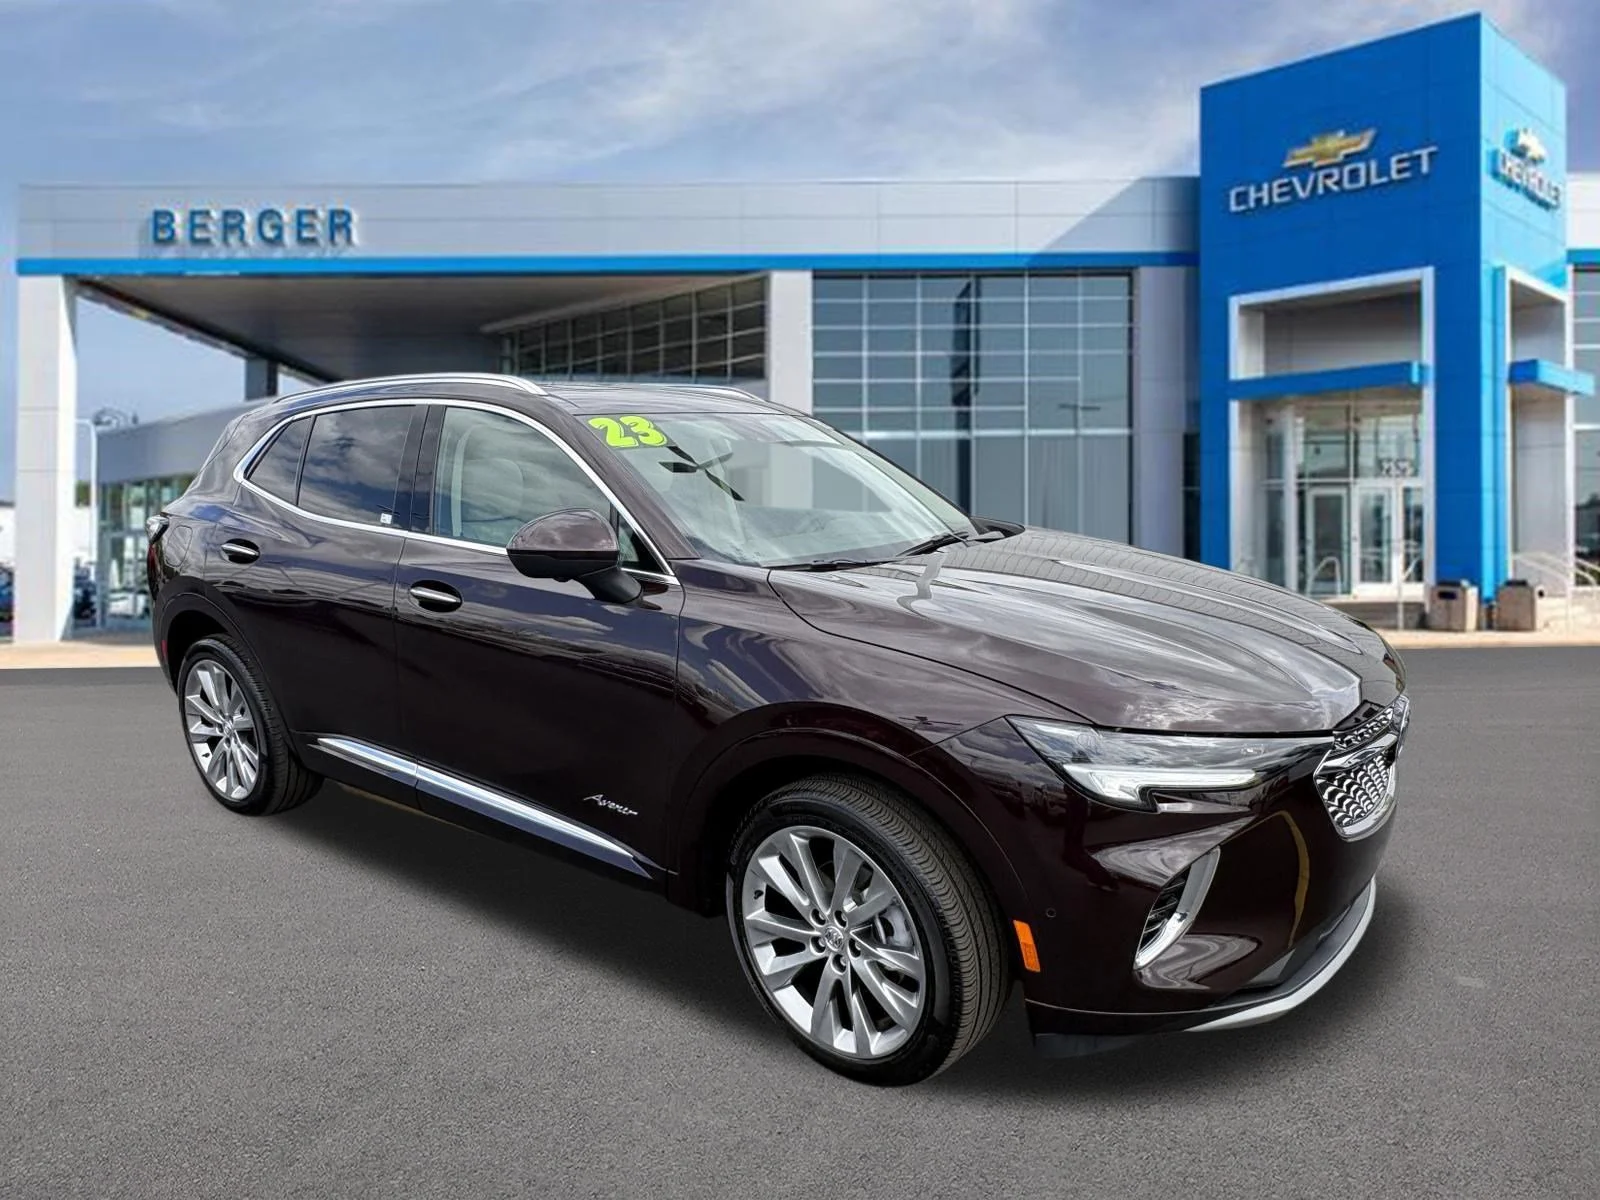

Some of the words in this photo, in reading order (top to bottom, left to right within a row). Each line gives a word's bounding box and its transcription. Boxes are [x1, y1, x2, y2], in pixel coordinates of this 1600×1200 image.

[1228, 147, 1439, 212] CHEVROLET
[152, 208, 355, 246] BERGER
[587, 415, 668, 448] 23
